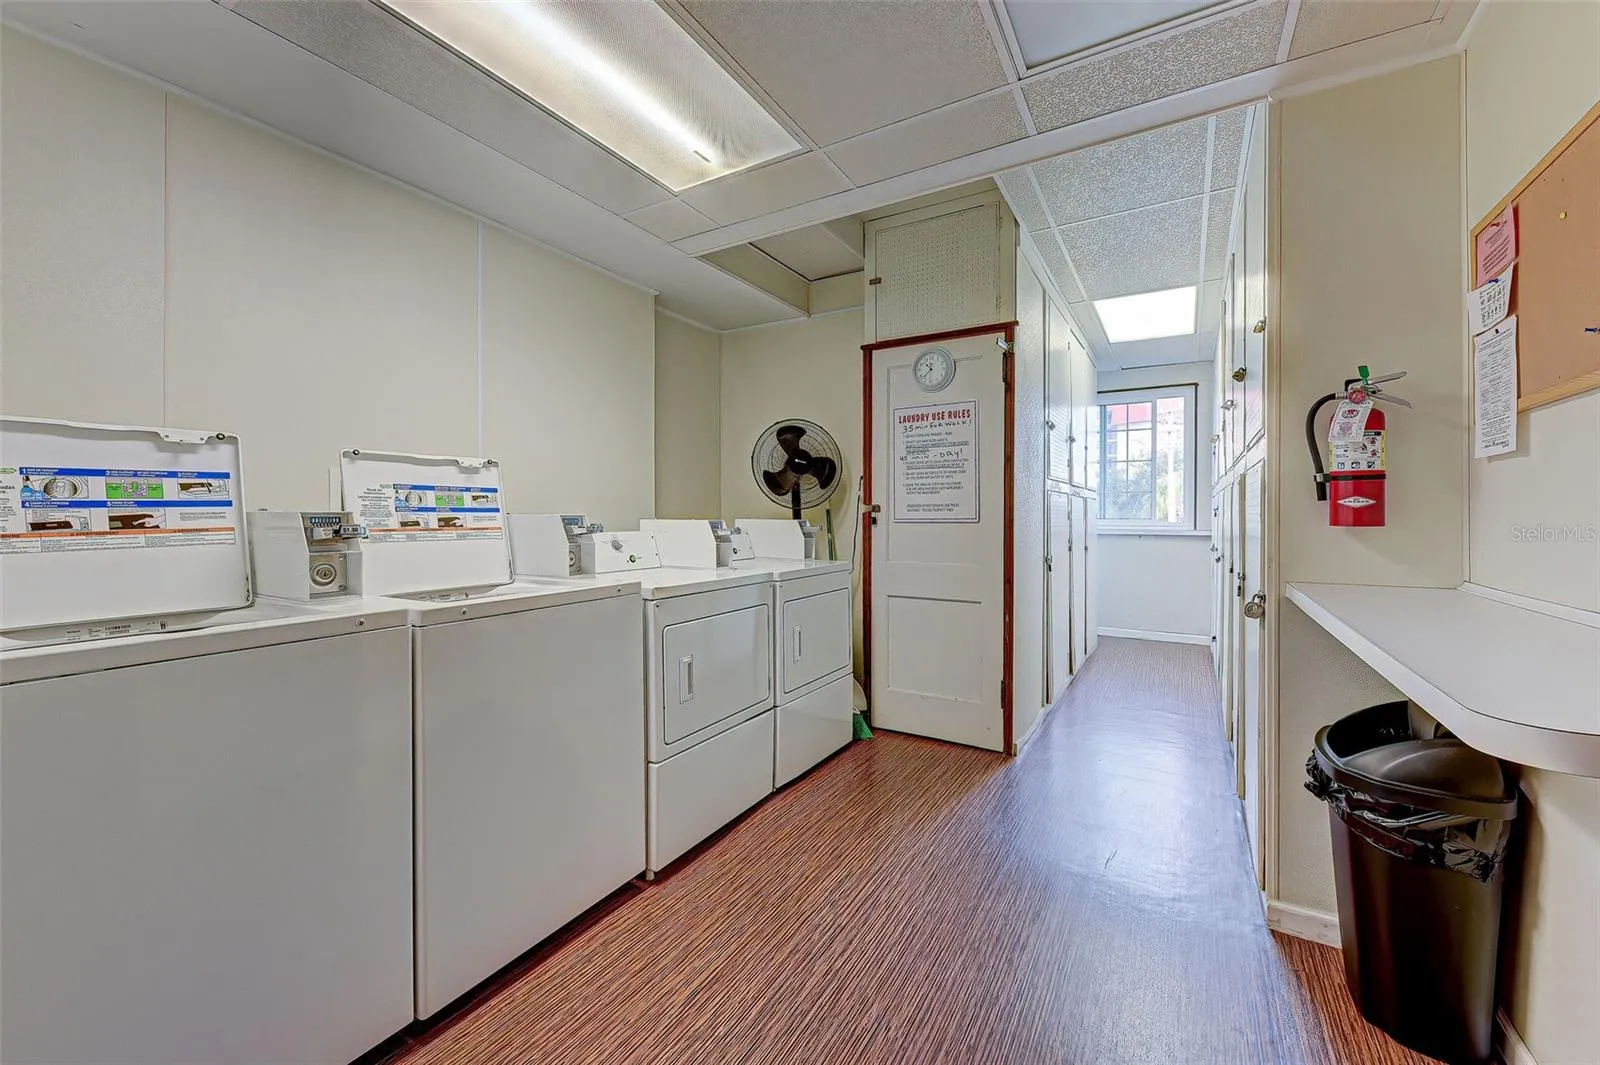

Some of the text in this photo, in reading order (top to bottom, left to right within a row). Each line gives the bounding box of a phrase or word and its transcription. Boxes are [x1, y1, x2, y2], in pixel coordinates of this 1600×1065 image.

[899, 409, 971, 424] LAUNDRY USE RULES
